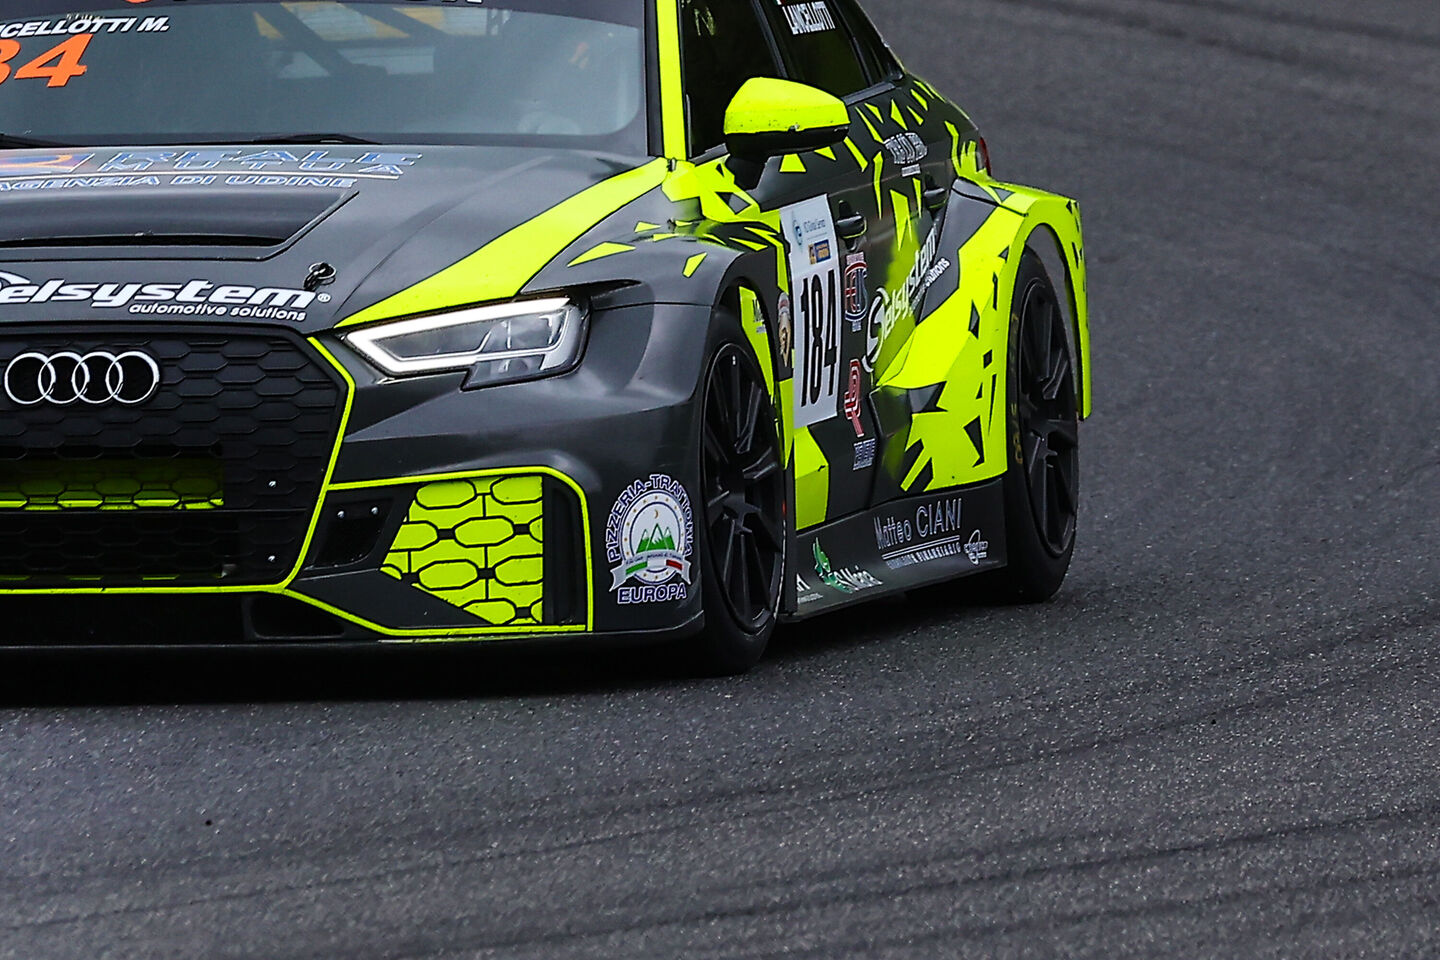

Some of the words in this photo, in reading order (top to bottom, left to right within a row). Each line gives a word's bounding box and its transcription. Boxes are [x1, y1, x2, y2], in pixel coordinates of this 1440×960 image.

[136, 17, 170, 33] M.
[128, 302, 227, 317] automotive
[229, 306, 307, 322] solutions
[800, 269, 838, 408] 184
[916, 498, 962, 538] CIANI
[617, 583, 687, 604] EUROPA
